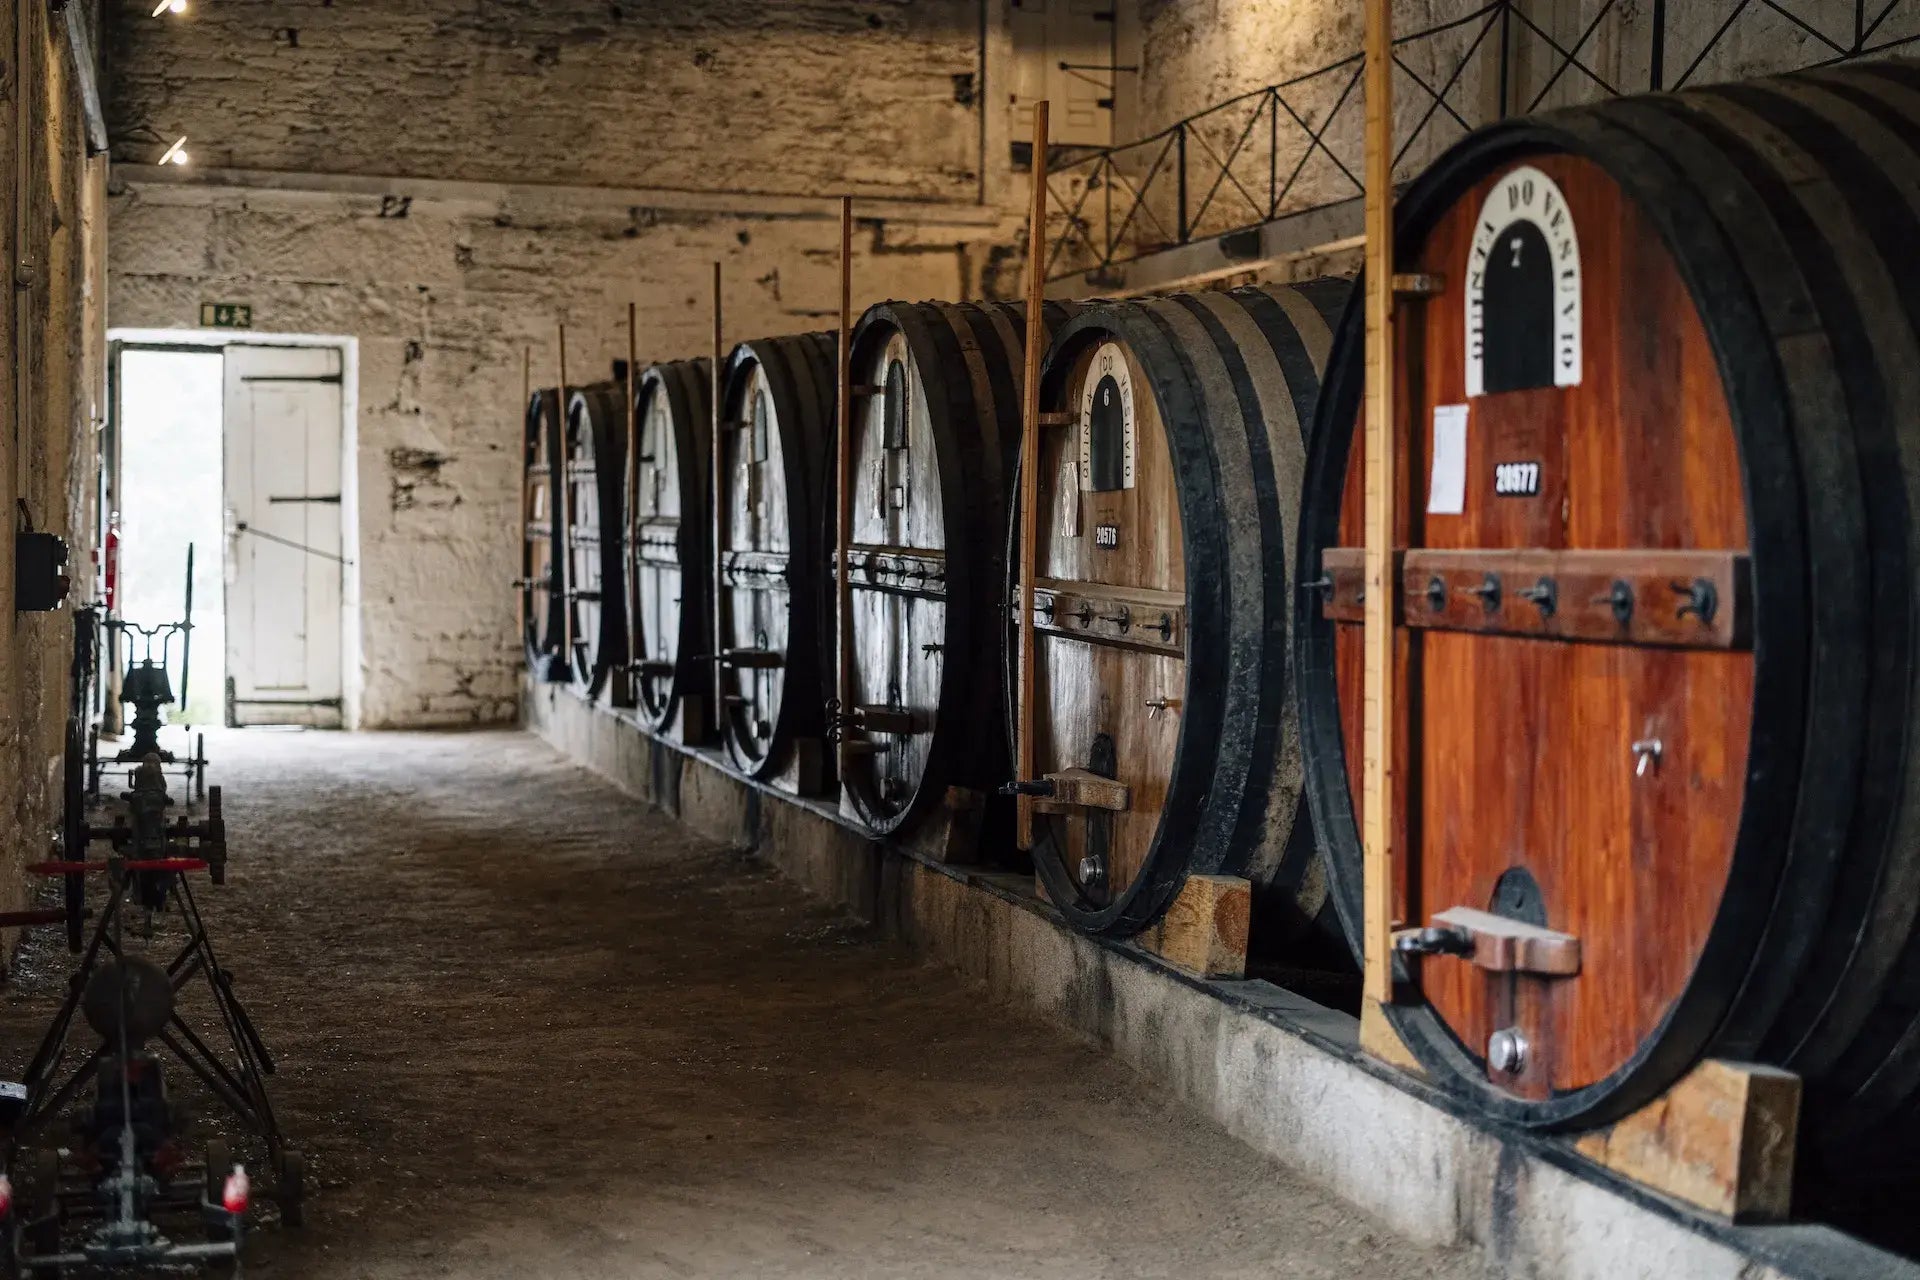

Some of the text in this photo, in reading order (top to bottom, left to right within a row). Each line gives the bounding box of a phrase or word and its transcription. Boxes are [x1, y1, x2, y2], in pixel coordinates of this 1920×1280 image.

[1507, 179, 1534, 212] DO
[1103, 387, 1110, 407] 6
[1083, 355, 1131, 479] QUINTA DO VESUVIO
[1096, 526, 1117, 545] 20576
